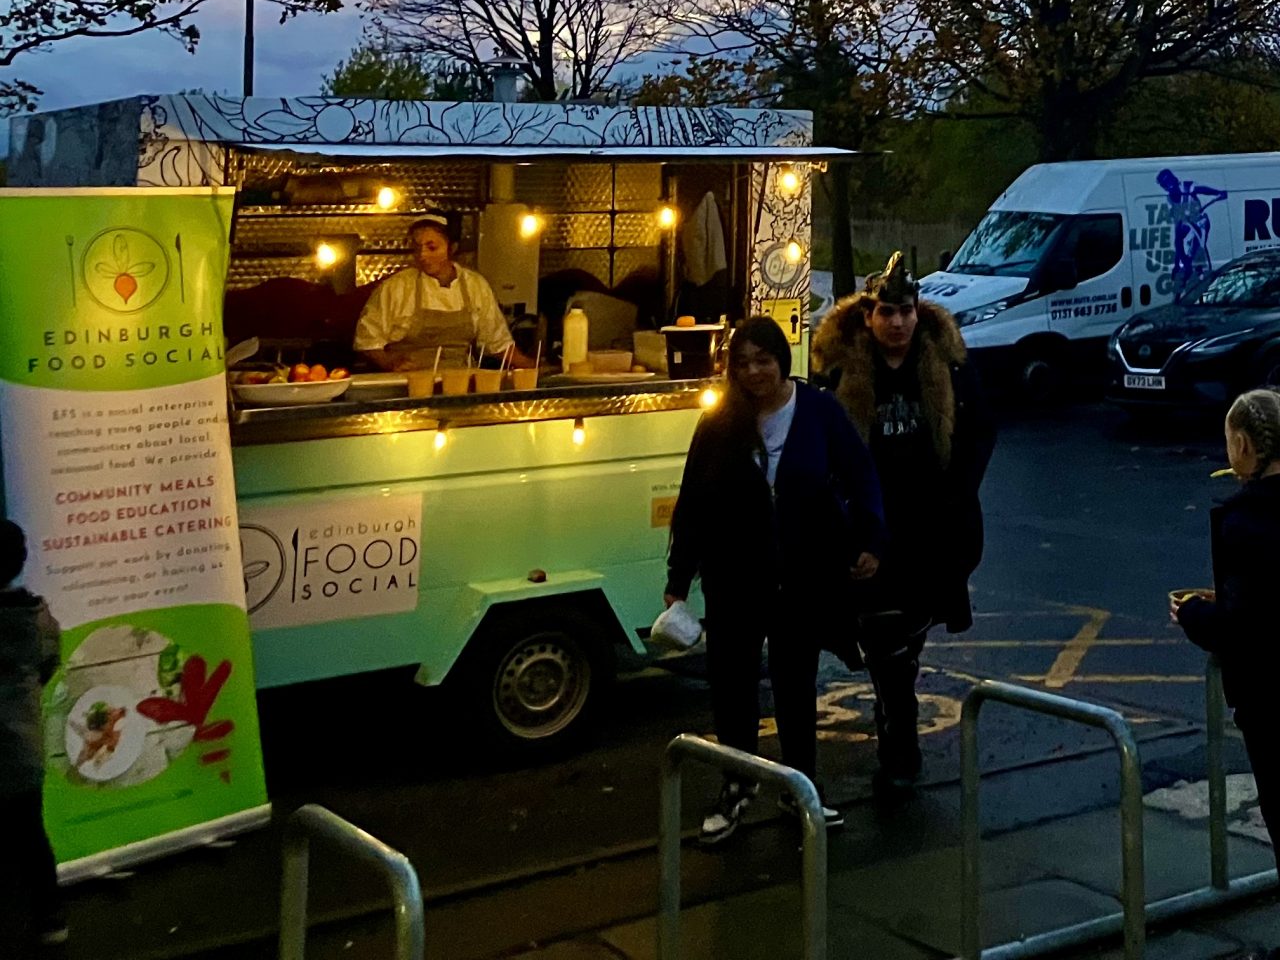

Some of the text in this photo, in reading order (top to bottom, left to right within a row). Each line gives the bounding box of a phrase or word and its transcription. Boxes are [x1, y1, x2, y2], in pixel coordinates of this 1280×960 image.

[1129, 226, 1172, 251] LIFE
[919, 282, 967, 297] UTS
[43, 322, 213, 347] EDINBURGH
[27, 346, 224, 374] FOOD SOCIAL
[149, 399, 214, 414] enterprise
[148, 417, 191, 433] people
[197, 413, 219, 425] and
[136, 436, 174, 450] about
[144, 454, 165, 466] We
[170, 448, 218, 464] provide
[54, 474, 216, 506] COMMUNITY MEALS
[66, 496, 212, 527] FOOD EDUCATION
[42, 515, 232, 553] SUSTAINABLE CATERING
[309, 516, 416, 540] edinburgh
[156, 548, 171, 561] by
[176, 541, 232, 558] donating
[303, 537, 418, 578] FOOD
[162, 563, 206, 578] having
[301, 572, 416, 601] SOCIAL
